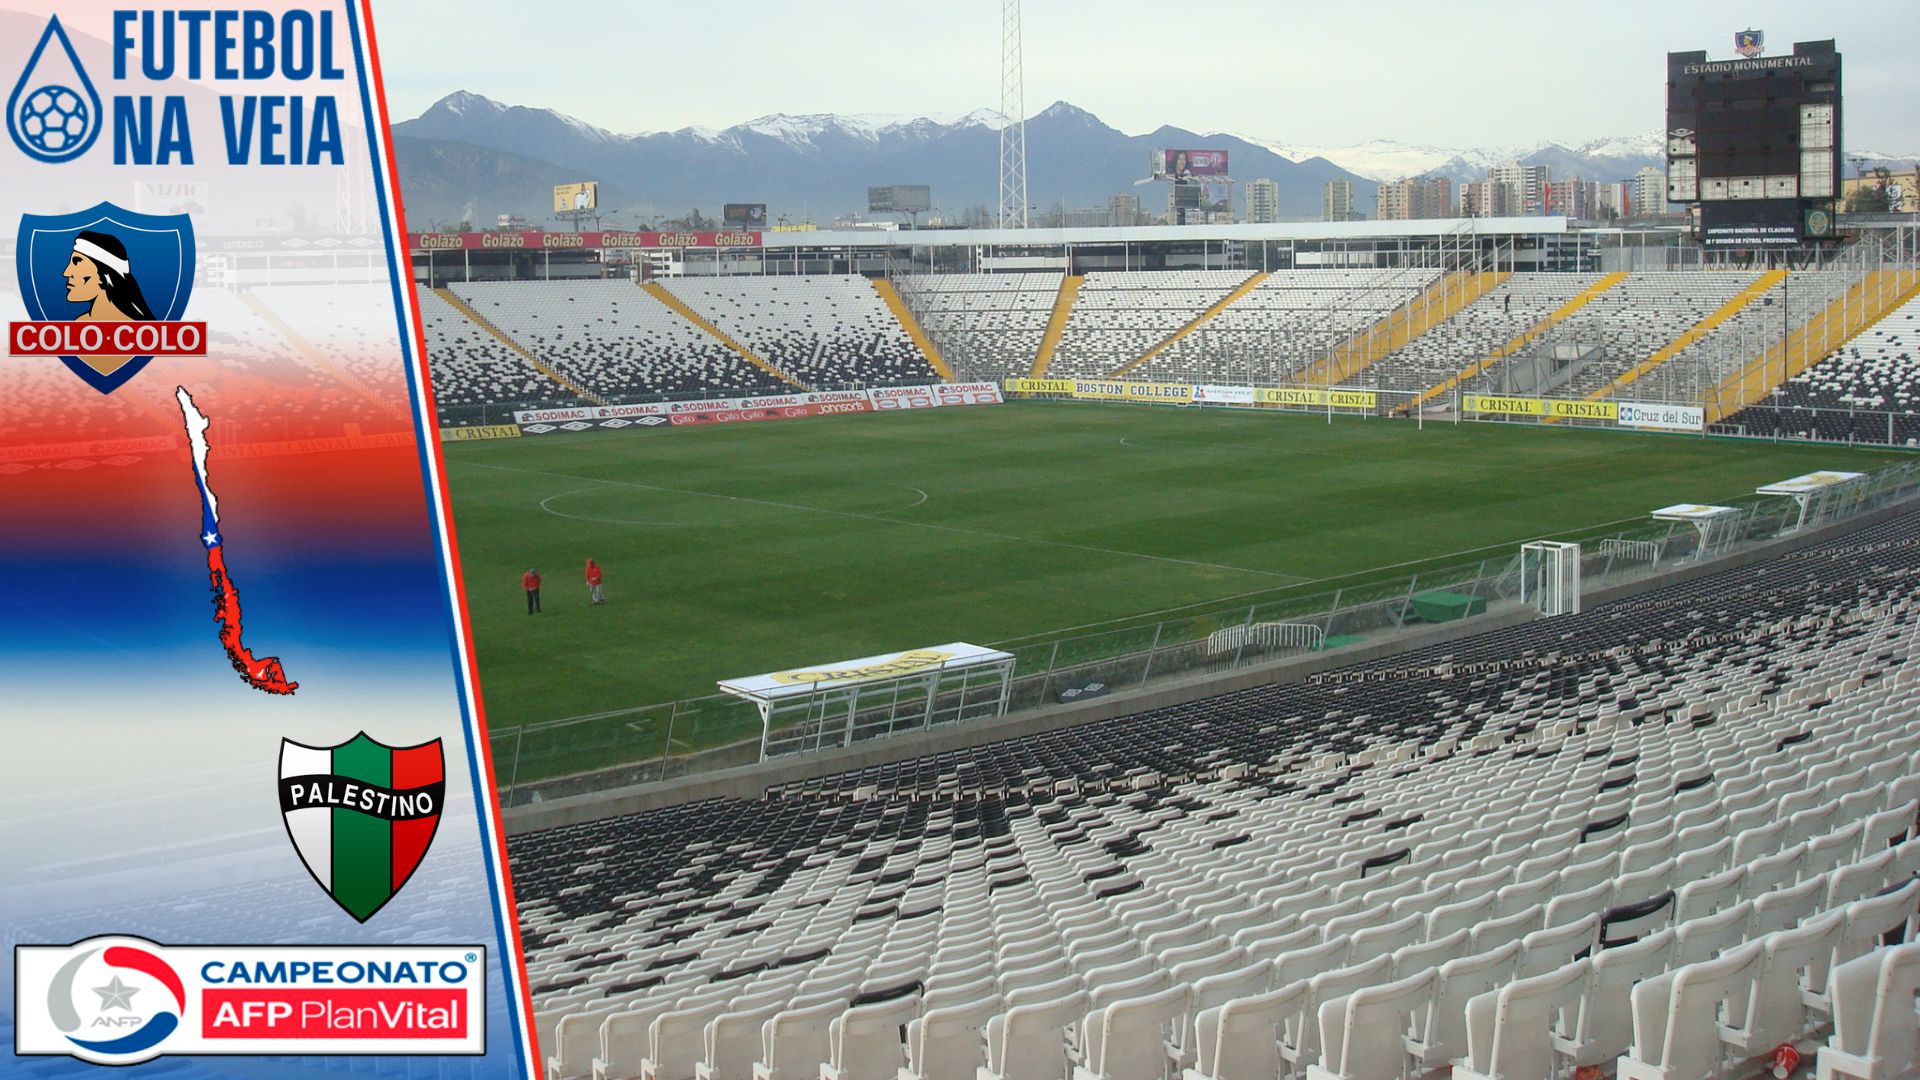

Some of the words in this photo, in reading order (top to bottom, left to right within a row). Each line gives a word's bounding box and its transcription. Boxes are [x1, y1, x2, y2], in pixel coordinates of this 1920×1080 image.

[1684, 62, 1731, 74] ESTADIO
[1734, 57, 1813, 71] MONUMENTAL
[420, 234, 463, 248] Golazo
[482, 234, 524, 248] Golazo
[543, 233, 583, 247] Golazo
[602, 233, 641, 246] Golazo
[659, 233, 697, 246] Golazo
[715, 232, 753, 246] Golazo
[950, 384, 993, 394] SODIMAC
[1021, 380, 1068, 391] CRISTAL
[1076, 383, 1123, 394] BOSTON
[1130, 385, 1188, 397] COLLEGE
[819, 392, 862, 402] SODIMAC
[884, 388, 926, 397] SODIMAC
[1267, 391, 1315, 403] CRISTAL
[1330, 393, 1374, 405] CRISTAL
[684, 401, 729, 412] SODIMAC
[751, 397, 797, 407] SODIMAC
[1480, 399, 1532, 412] CRISTAL
[534, 409, 585, 421] SODIMAC
[612, 406, 659, 416] SODIMAC
[1556, 402, 1611, 416] CRISTAL
[1633, 411, 1659, 422] Cruz
[1663, 412, 1678, 424] del
[1682, 413, 1702, 425] Sur
[456, 425, 517, 439] CRISTAL
